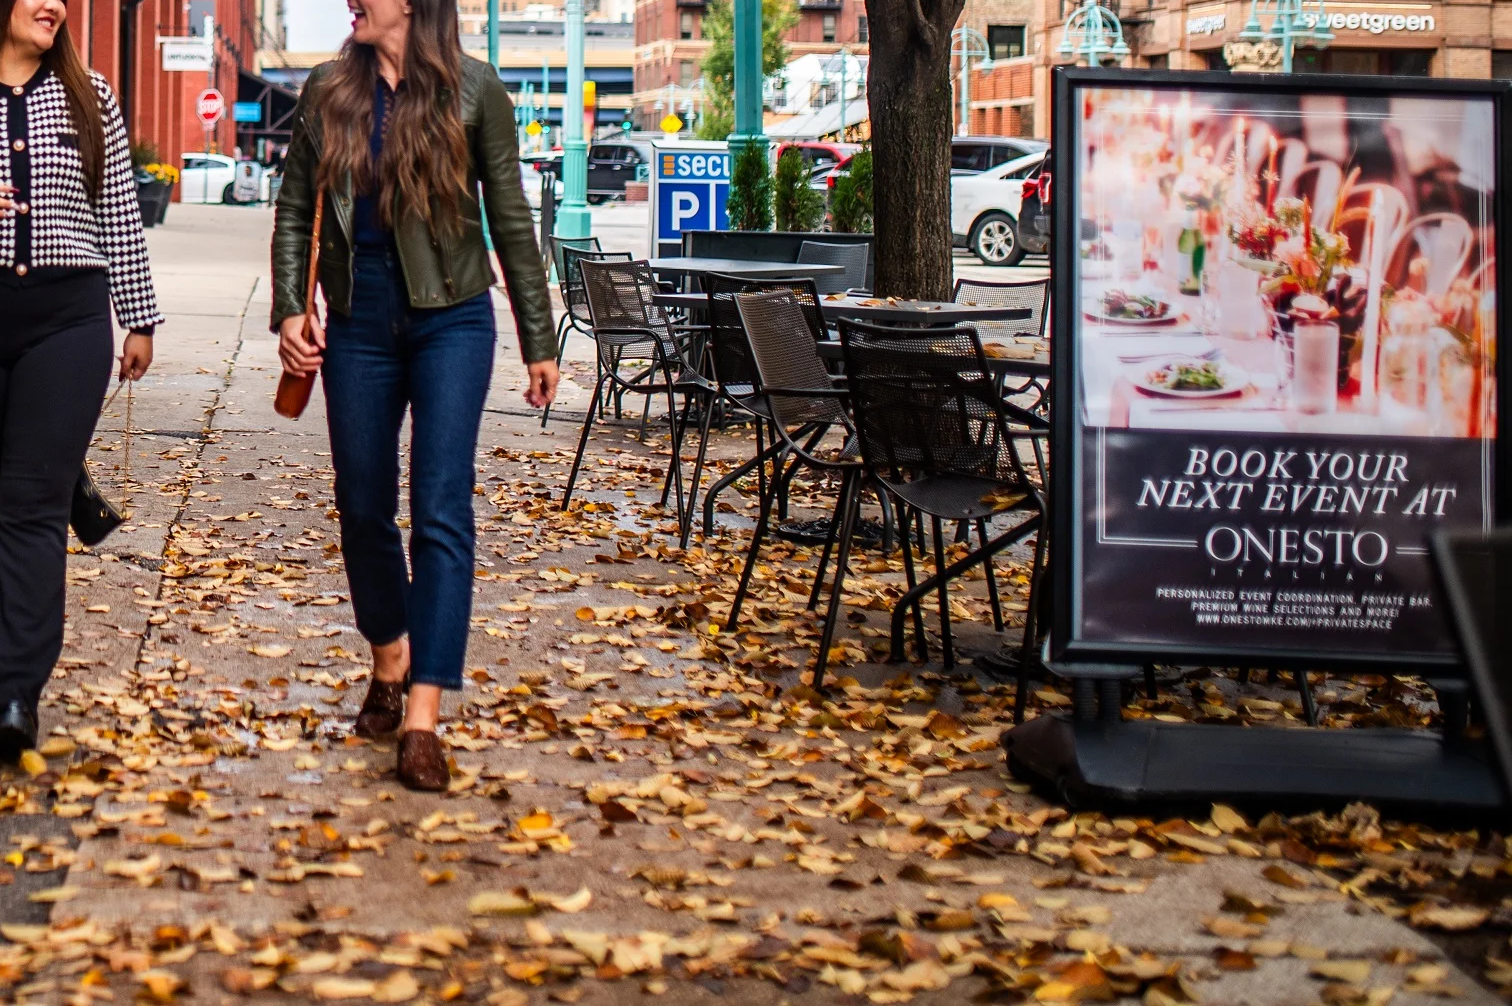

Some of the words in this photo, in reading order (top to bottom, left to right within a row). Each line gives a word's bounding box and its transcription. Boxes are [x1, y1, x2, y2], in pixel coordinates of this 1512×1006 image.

[672, 191, 700, 231] P
[1184, 448, 1297, 479] BOOK
[1304, 451, 1410, 482] YOUR
[1136, 479, 1253, 510] NEXT
[1260, 483, 1399, 514] EVENT
[1401, 487, 1457, 516] AT
[1204, 525, 1389, 566] ONESTO
[1210, 568, 1383, 582] ITALIAN
[1156, 588, 1235, 600] PERSONALIZED
[1239, 590, 1272, 601] EVENT
[1361, 594, 1405, 606] PRIVATE
[1191, 601, 1239, 612] PREMIUM
[1242, 602, 1268, 614] WINE
[1272, 603, 1336, 616] SELECTIONS
[1340, 606, 1366, 617] AND
[1367, 607, 1400, 618] MORE!
